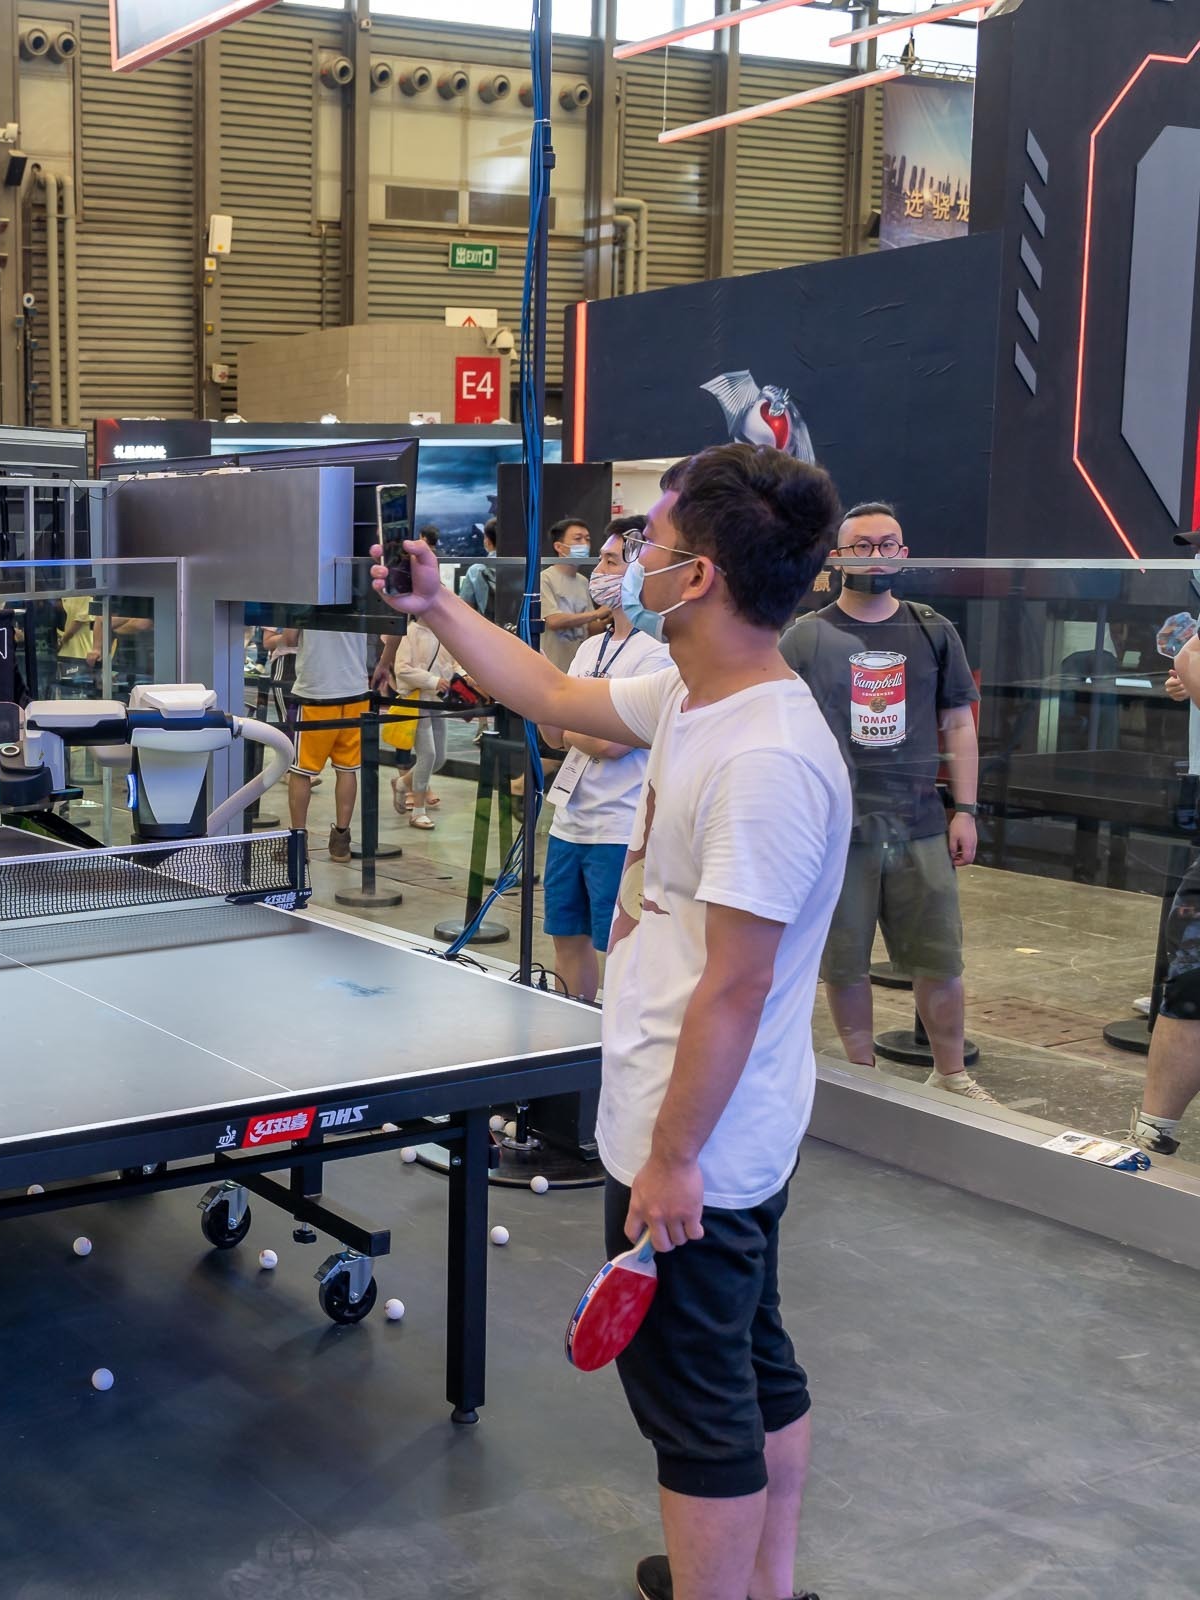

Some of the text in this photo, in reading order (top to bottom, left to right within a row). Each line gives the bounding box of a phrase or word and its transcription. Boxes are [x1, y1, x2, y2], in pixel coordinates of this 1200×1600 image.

[461, 371, 495, 399] E4
[858, 714, 898, 724] TOMATO
[861, 725, 897, 736] SOUP
[318, 1105, 369, 1128] DHS
